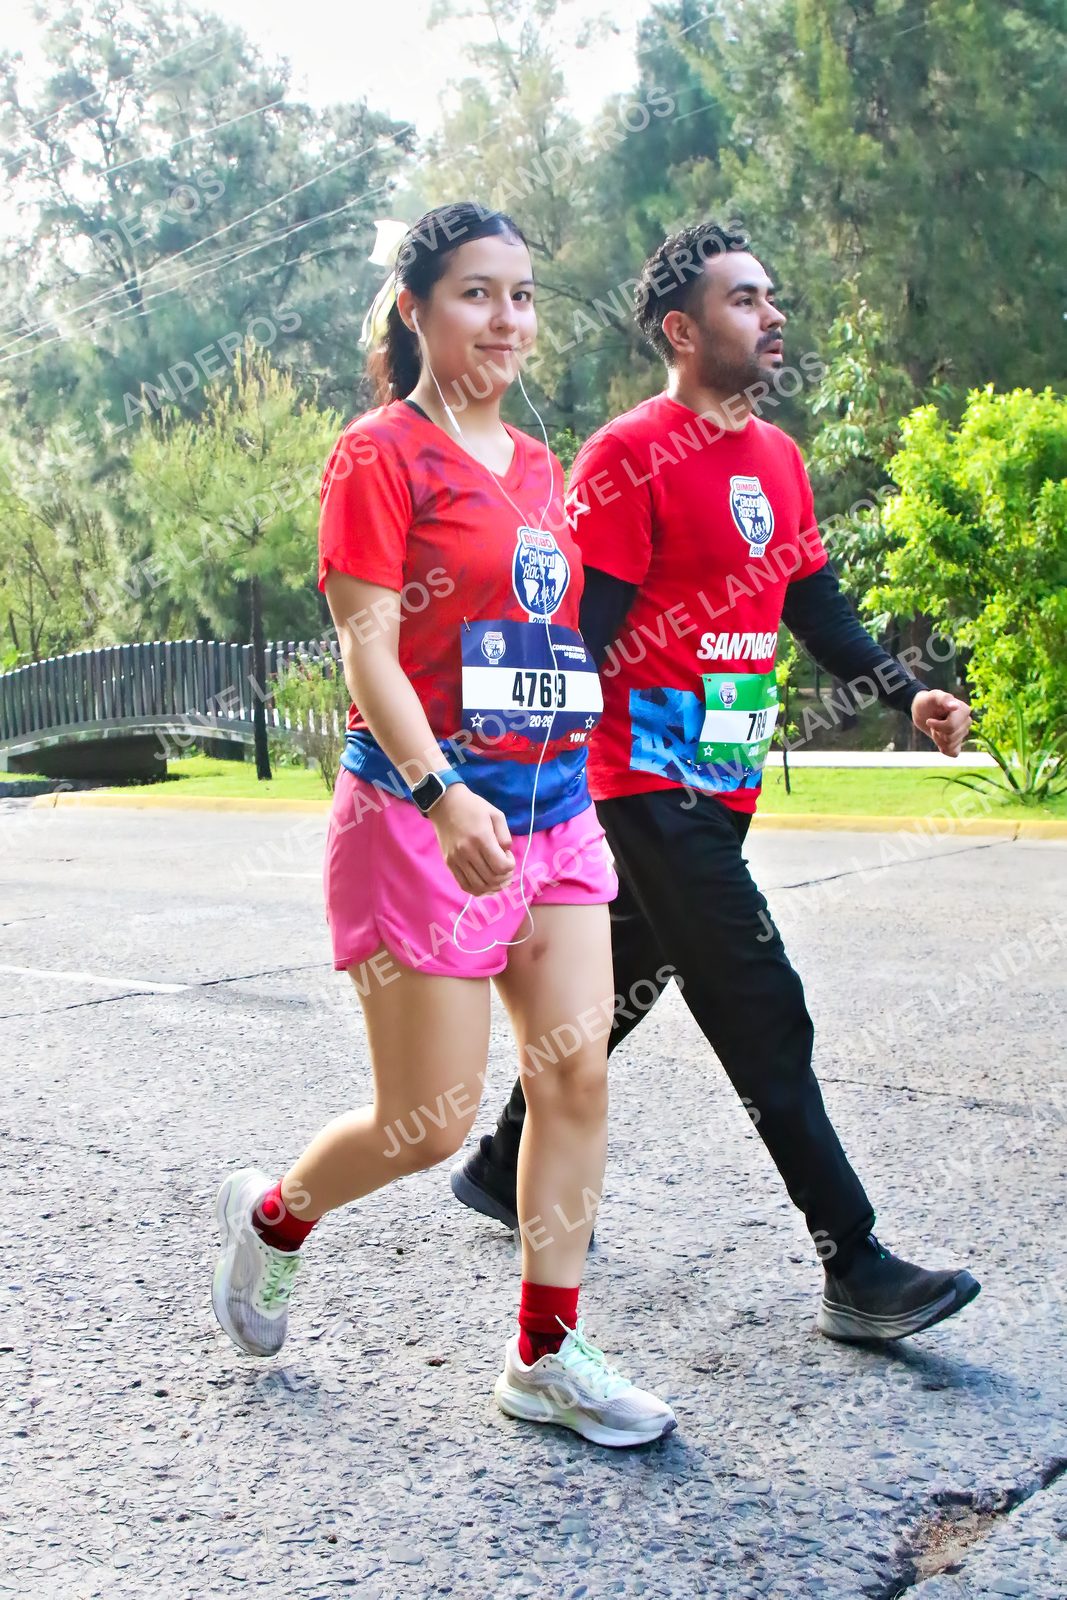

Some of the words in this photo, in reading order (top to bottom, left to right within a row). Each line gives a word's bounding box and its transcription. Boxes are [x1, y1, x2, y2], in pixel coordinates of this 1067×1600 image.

[736, 482, 758, 492] BIMBO
[528, 549, 556, 569] Glbal
[697, 632, 778, 661] SANTIAGO
[511, 671, 567, 709] 4769
[569, 733, 587, 743] 10K
